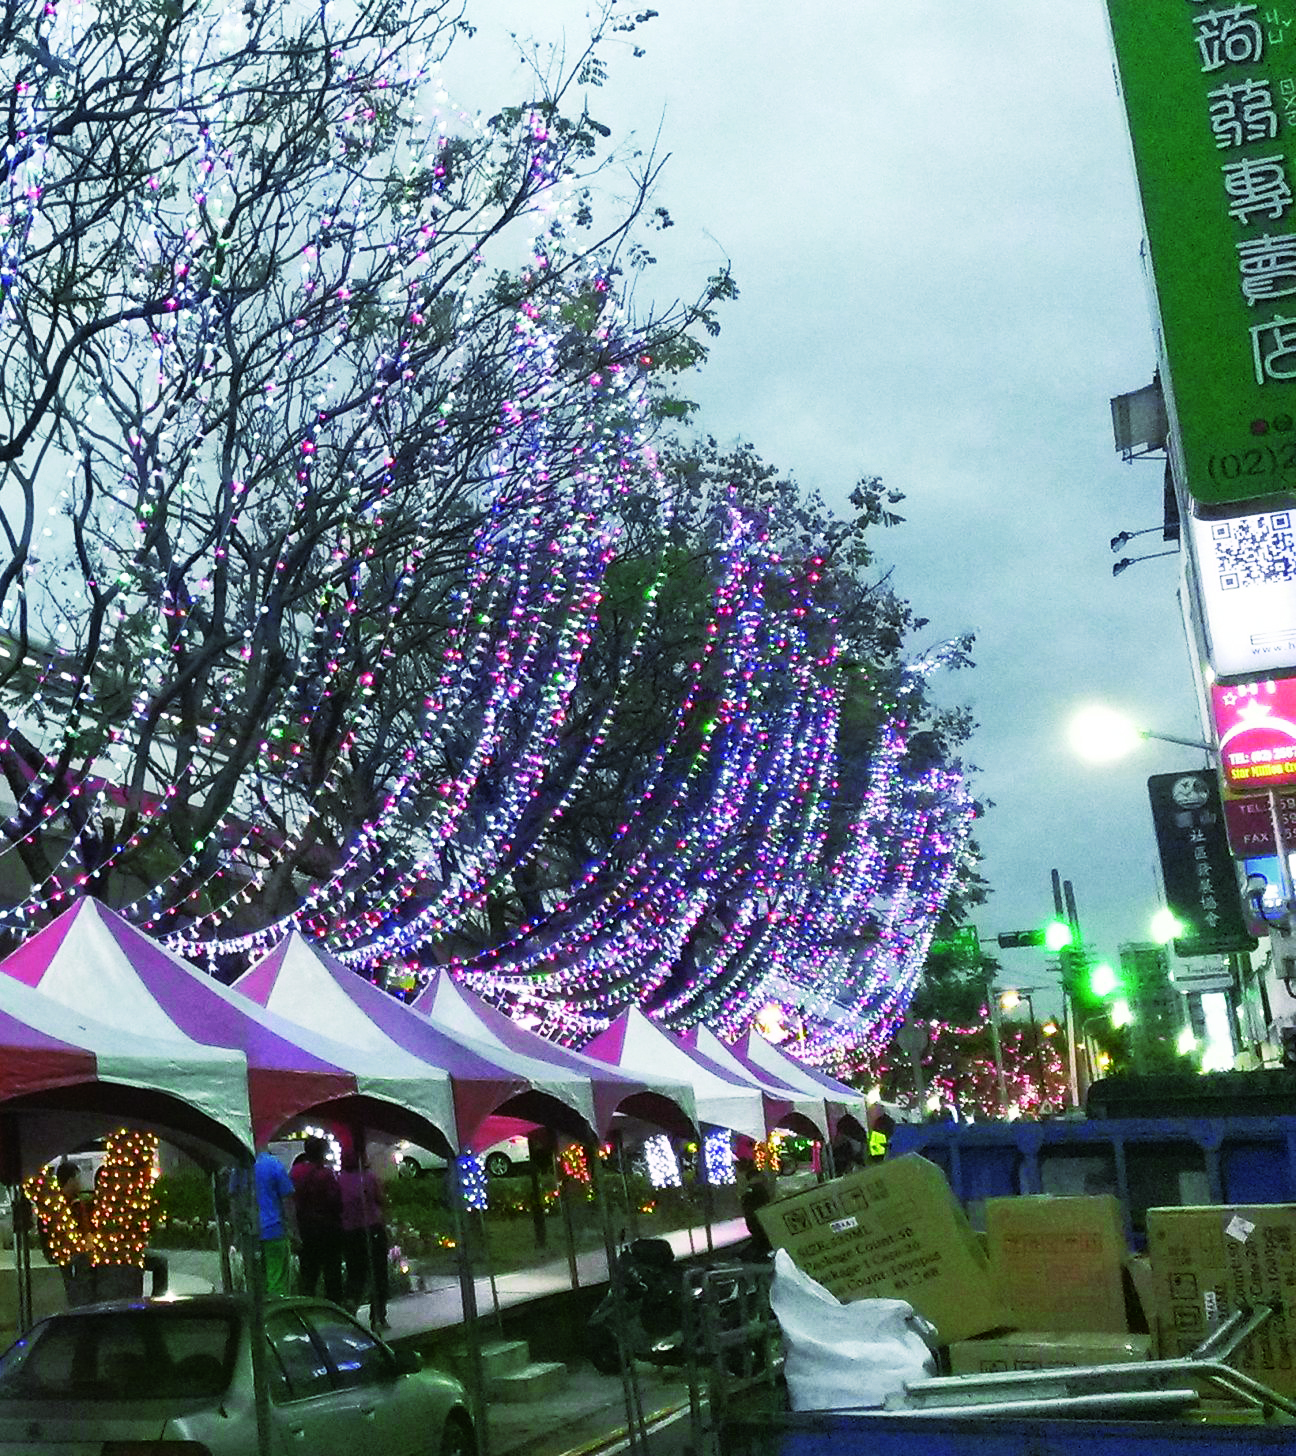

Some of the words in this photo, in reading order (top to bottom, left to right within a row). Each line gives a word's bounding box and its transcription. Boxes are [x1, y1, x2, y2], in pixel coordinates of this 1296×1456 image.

[1192, 2, 1296, 385] 蒟蒻專賣店
[1243, 832, 1269, 844] FAX
